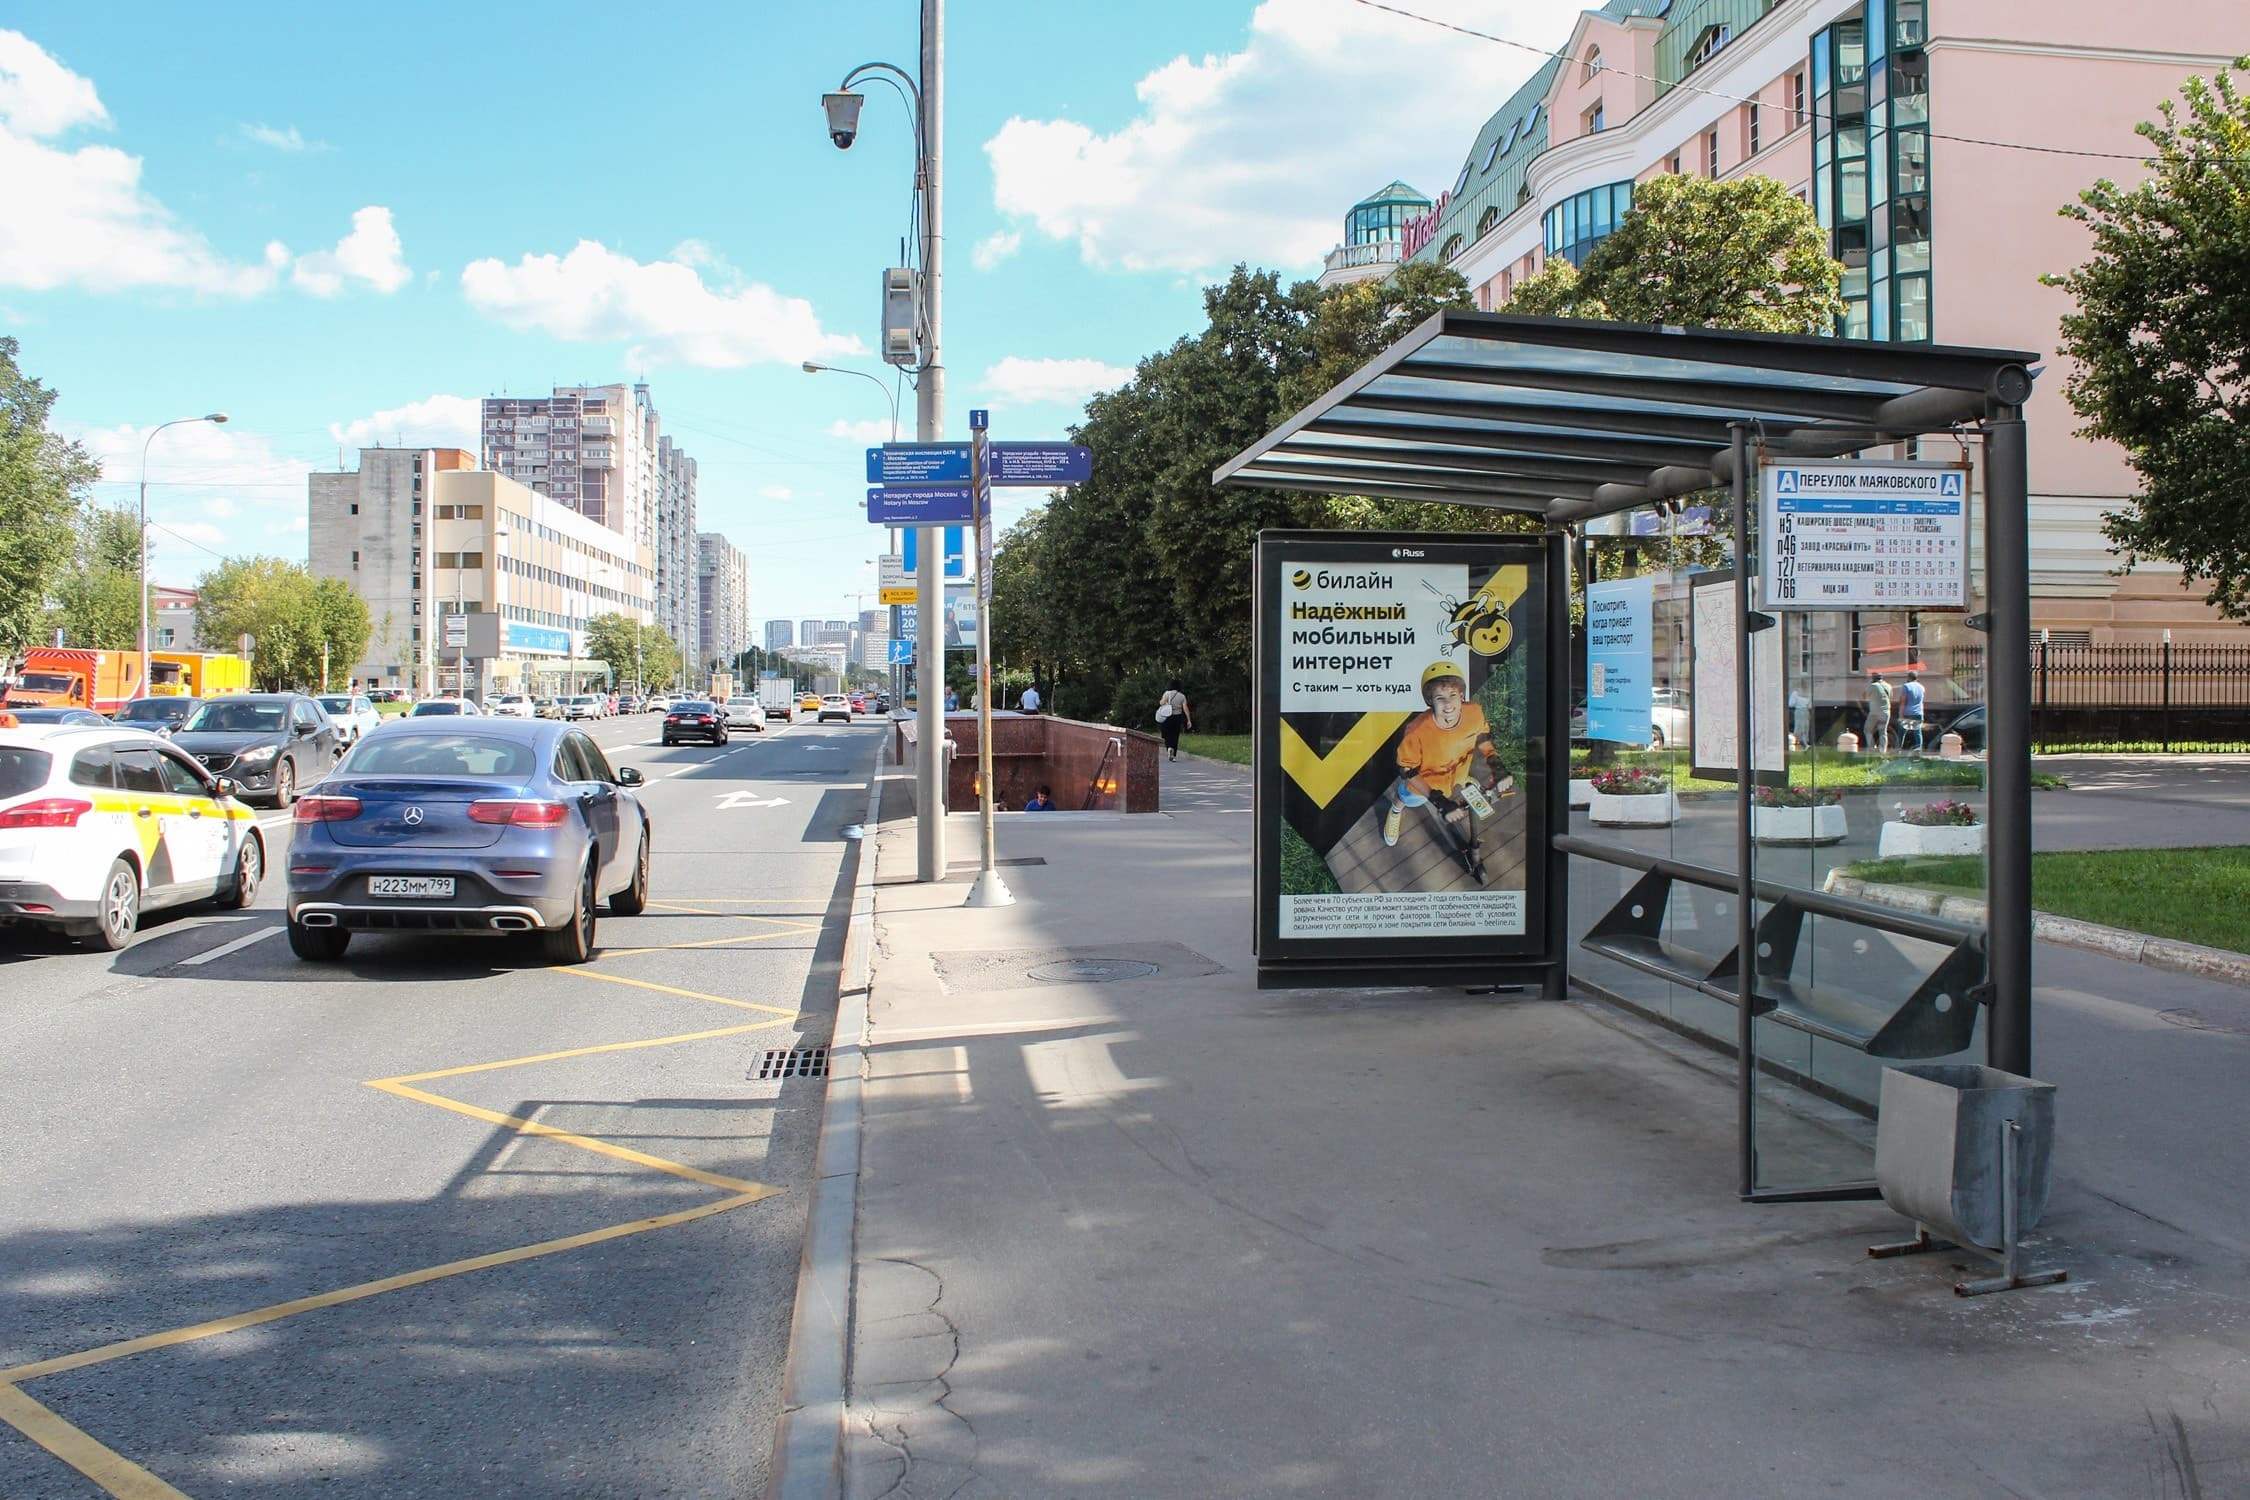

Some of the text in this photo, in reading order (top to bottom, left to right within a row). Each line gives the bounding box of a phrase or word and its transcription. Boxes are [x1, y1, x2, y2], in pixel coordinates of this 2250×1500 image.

[1800, 474, 1856, 488] ПЕРЕУЛОК
[1860, 476, 1936, 488] МАЯКОВСКОГО
[1798, 517, 1832, 526] КАШИРСКОЕ
[1834, 518, 1853, 526] ШОССЕ
[1801, 542, 1820, 551] ЗАВОД
[1822, 541, 1852, 550] «КРАСНЫЙ
[1854, 543, 1871, 551] ПУТЬ»
[1402, 549, 1424, 557] Russ
[1798, 563, 1840, 572] ВЕТЕРИНАРНАЯ
[1843, 563, 1874, 572] АКАДЕМИЯ
[1317, 570, 1392, 589] билайн
[1778, 579, 1795, 598] 766
[1823, 585, 1835, 593] МЦК
[1838, 585, 1848, 593] ЗИЛ
[1292, 602, 1406, 622] Надёжный
[1592, 600, 1627, 613] Посмотрите,
[1592, 617, 1632, 630] когда приедет
[1292, 627, 1415, 645] мобильный
[1592, 633, 1633, 646] ваш транспорт
[1292, 655, 1392, 673] интернет
[1292, 683, 1300, 692] С
[1304, 683, 1338, 692] таким
[1356, 683, 1382, 692] хоть
[1385, 682, 1411, 694] куда
